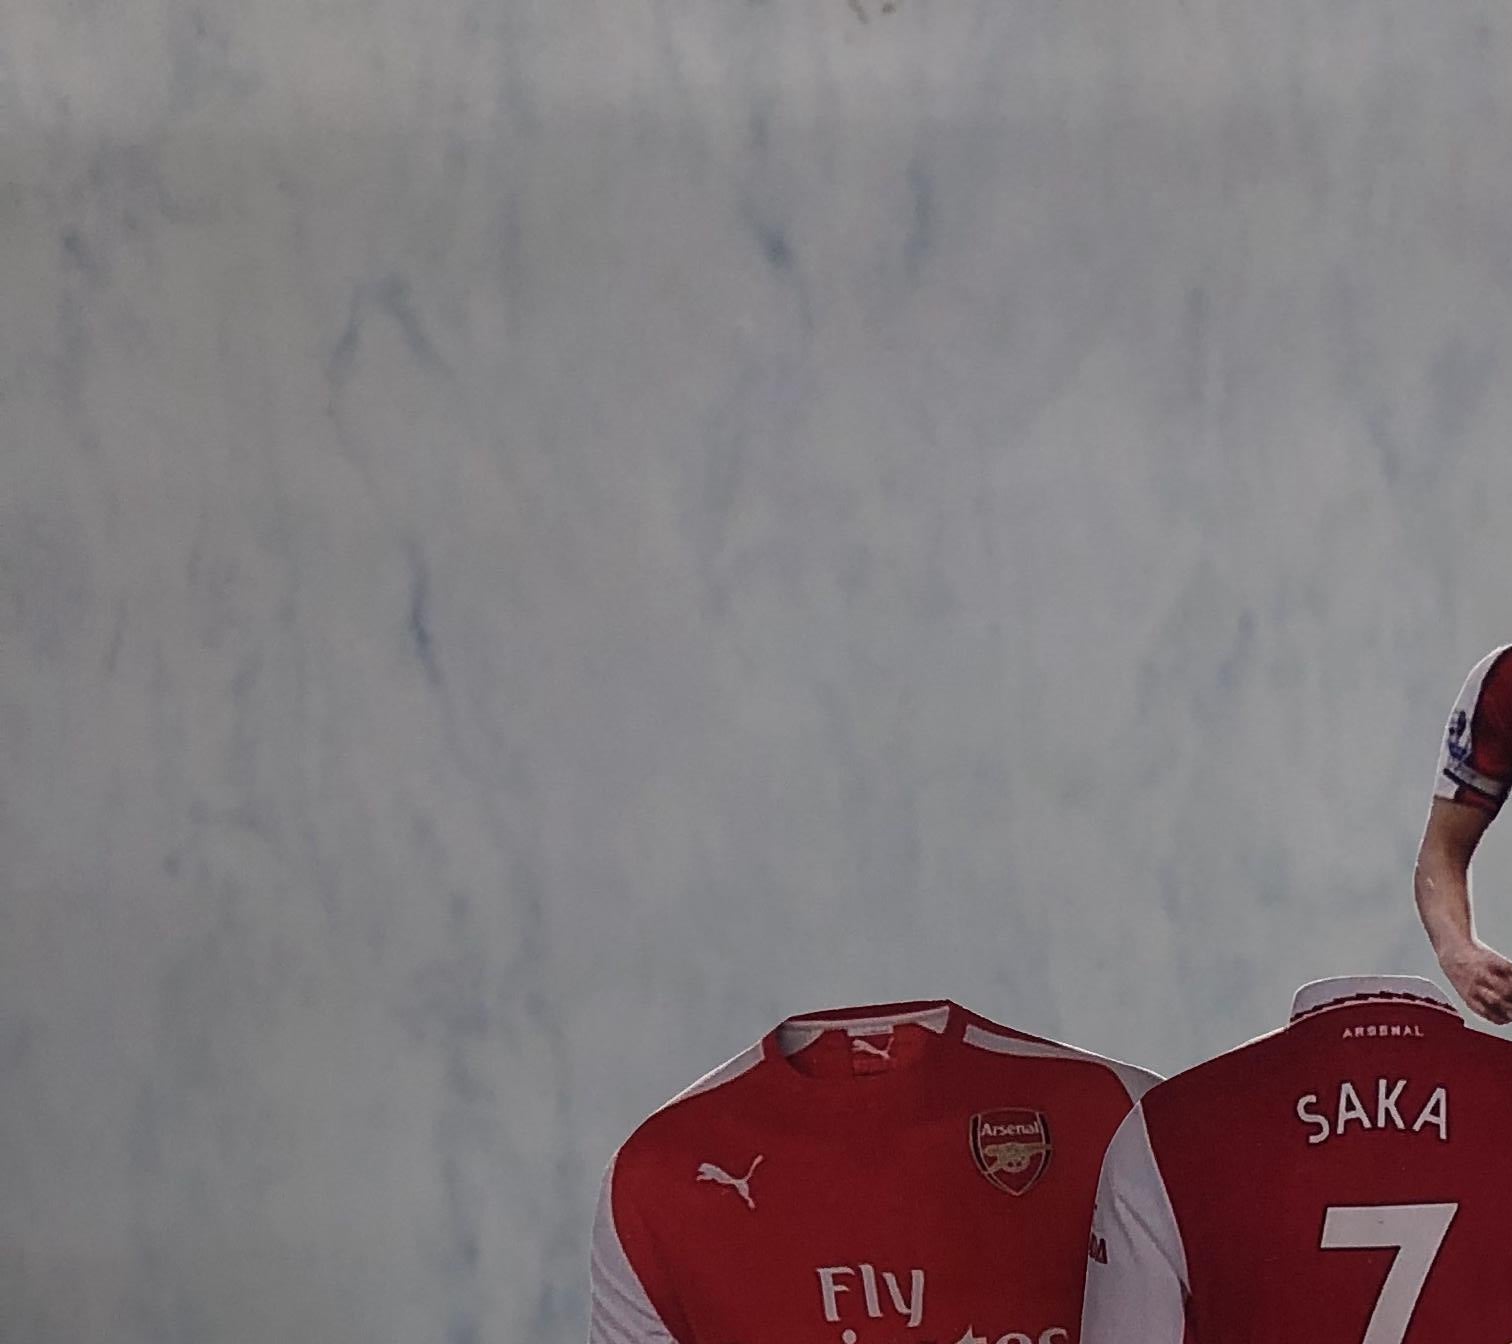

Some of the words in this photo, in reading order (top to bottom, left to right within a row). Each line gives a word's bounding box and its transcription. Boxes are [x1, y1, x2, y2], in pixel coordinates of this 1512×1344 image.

[1342, 1024, 1425, 1039] ARSENAL
[980, 1120, 1040, 1137] Arsenal
[1296, 1077, 1449, 1145] SAKA
[816, 1263, 925, 1327] Fly
